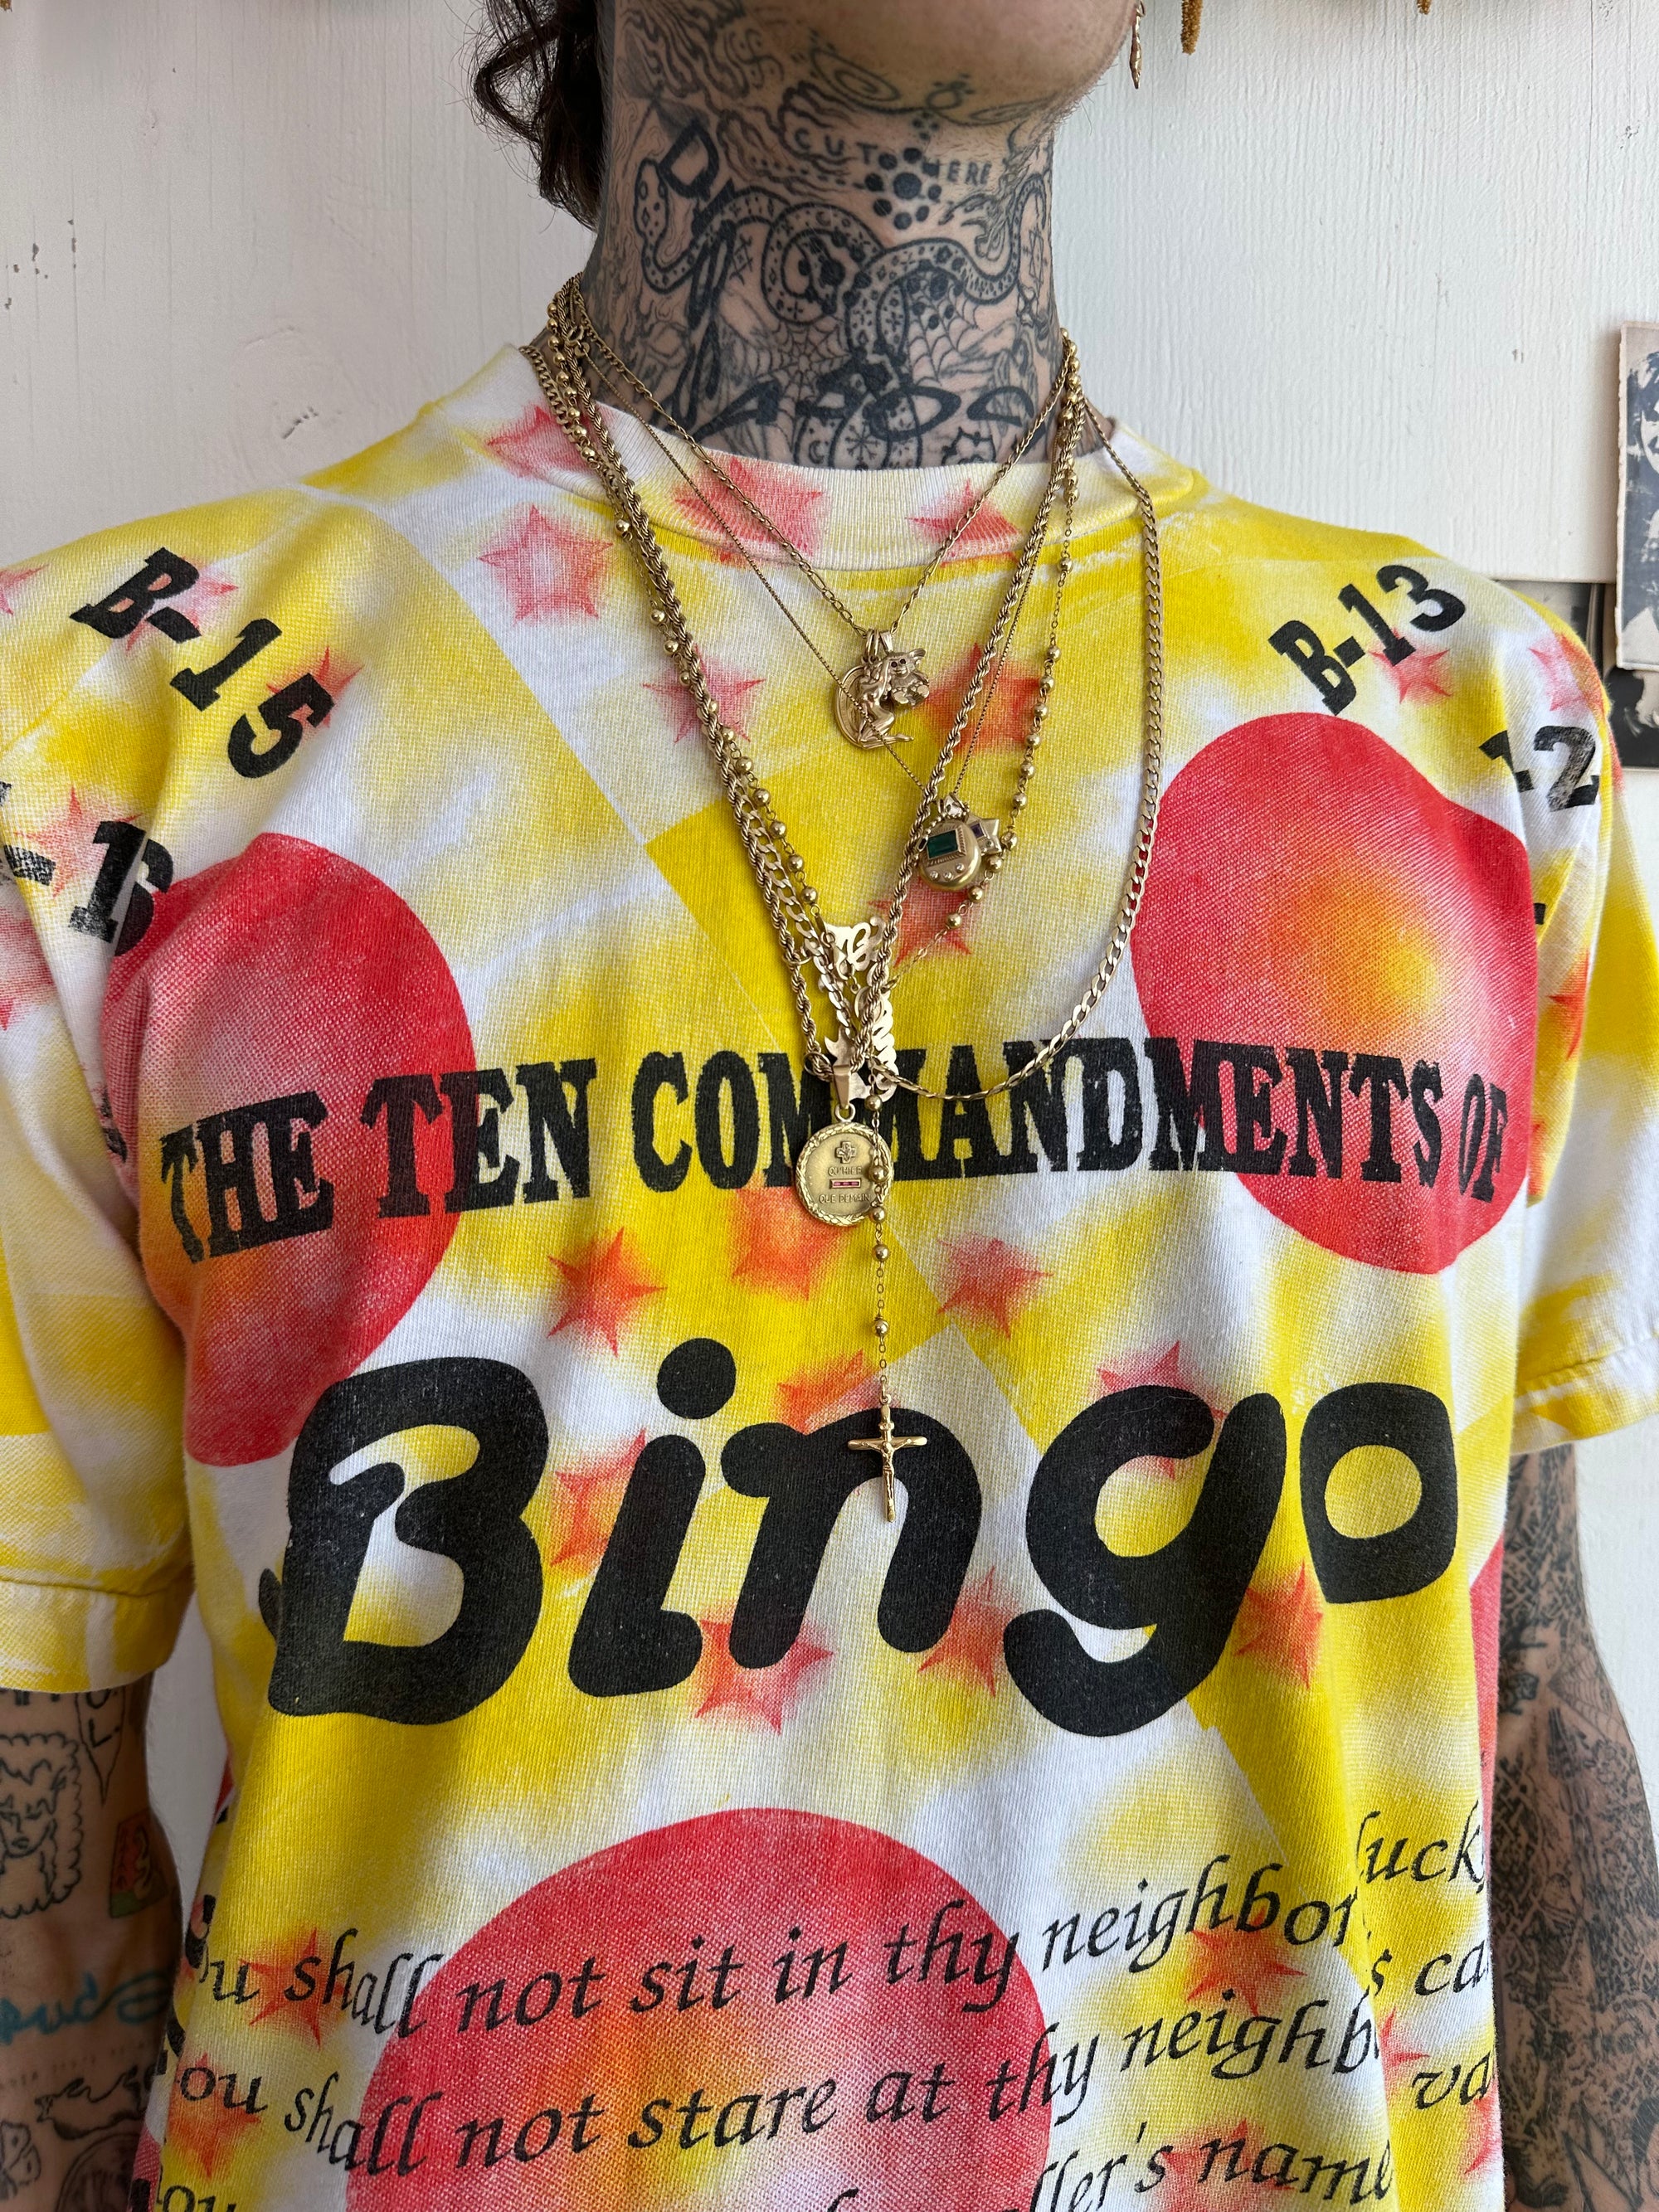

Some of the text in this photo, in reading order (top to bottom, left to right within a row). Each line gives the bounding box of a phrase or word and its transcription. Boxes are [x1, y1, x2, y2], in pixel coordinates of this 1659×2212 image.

[794, 127, 878, 165] CUT
[70, 547, 334, 778] B-15
[1269, 564, 1466, 715] B-13
[160, 1091, 333, 1263] THE
[361, 1057, 596, 1218] TEN
[1458, 1074, 1508, 1203] OF
[258, 1337, 1458, 1737] Bingo
[285, 1928, 445, 2039] shall
[456, 1956, 606, 2033] not
[630, 1934, 746, 2013] sit
[773, 1927, 854, 2004] in
[883, 1899, 1020, 2013] thy
[284, 2071, 443, 2176] shall
[455, 2093, 604, 2169] not
[628, 2078, 838, 2150] stare
[866, 2063, 955, 2123] at
[986, 2022, 1101, 2127] thy
